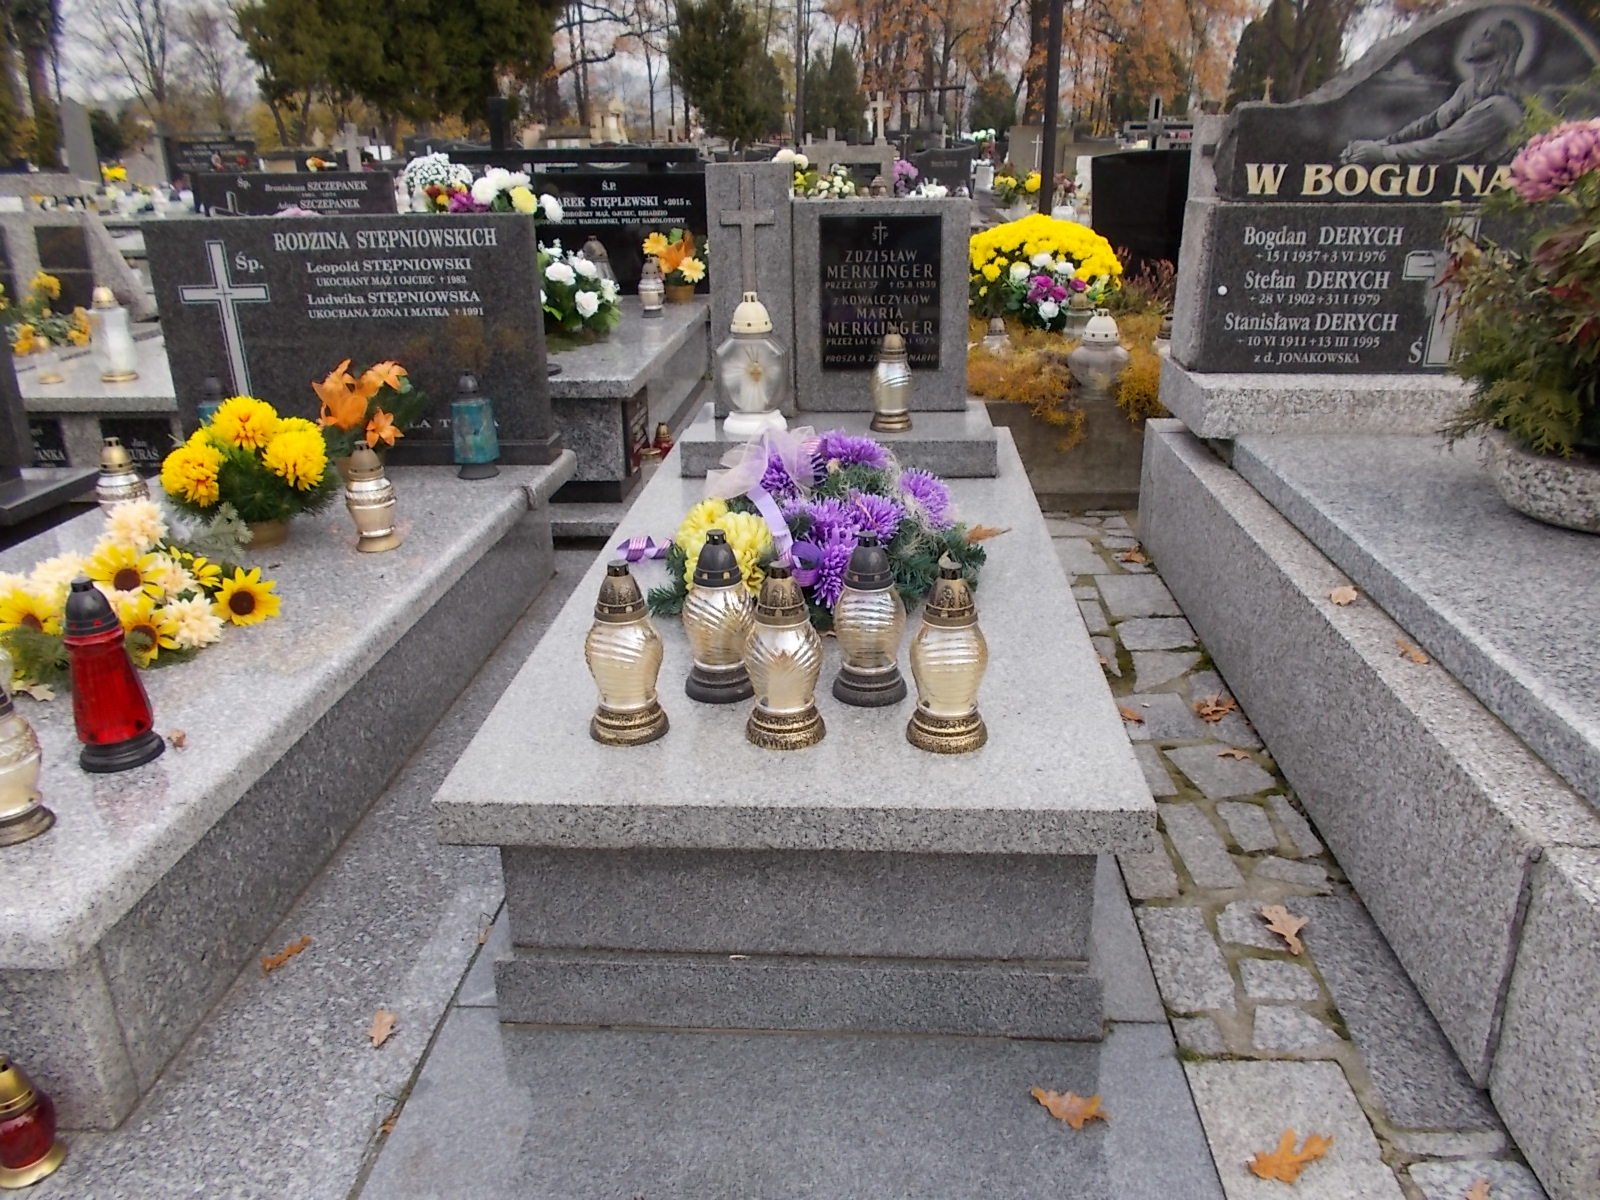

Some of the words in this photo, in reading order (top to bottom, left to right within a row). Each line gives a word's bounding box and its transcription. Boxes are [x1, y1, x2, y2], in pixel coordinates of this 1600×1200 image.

[307, 181, 367, 191] SZCZEPANEK
[1246, 163, 1288, 195] W
[1300, 163, 1440, 197] BOGU
[300, 199, 360, 209] SZCZEPANEK
[557, 197, 585, 207] AREK
[590, 196, 659, 209] STĘPLEWSKI
[273, 232, 349, 251] RODZINA
[357, 228, 498, 252] STĘPNIOWSKICH
[1243, 226, 1307, 249] Bogdan
[1318, 226, 1404, 246] DERYCH
[235, 252, 264, 273] Śp.
[844, 249, 918, 263] ZDZISŁAW
[1266, 251, 1280, 262] 15
[1341, 251, 1355, 262] VI
[1357, 251, 1387, 263] 1976
[307, 261, 359, 275] Leopold
[363, 258, 472, 274] STĘPNIOWSKI
[827, 264, 933, 279] MERKLINGER
[316, 277, 368, 287] UKOCHANY
[400, 276, 435, 285] OJCIEC
[825, 281, 851, 289] PRZEZ
[854, 281, 867, 289] LAT
[1244, 269, 1295, 290] Stefan
[1306, 271, 1390, 289] DERYCH
[307, 293, 365, 305] Ludwika
[367, 291, 480, 306] STĘPNIOWSKA
[1258, 294, 1273, 304] 28
[1352, 293, 1380, 305] 1979
[308, 309, 369, 319] UKOCHANA
[411, 307, 449, 317] MATKA
[463, 307, 484, 316] 1991
[856, 307, 904, 319] MARIA
[1224, 311, 1310, 331] Stanisława
[1315, 313, 1398, 332] DERYCH
[826, 337, 853, 346] PRZEZ
[1263, 336, 1277, 347] VI
[1334, 336, 1350, 347] III
[1353, 336, 1380, 348] 1995
[1276, 352, 1360, 365] JONAKOWSKA
